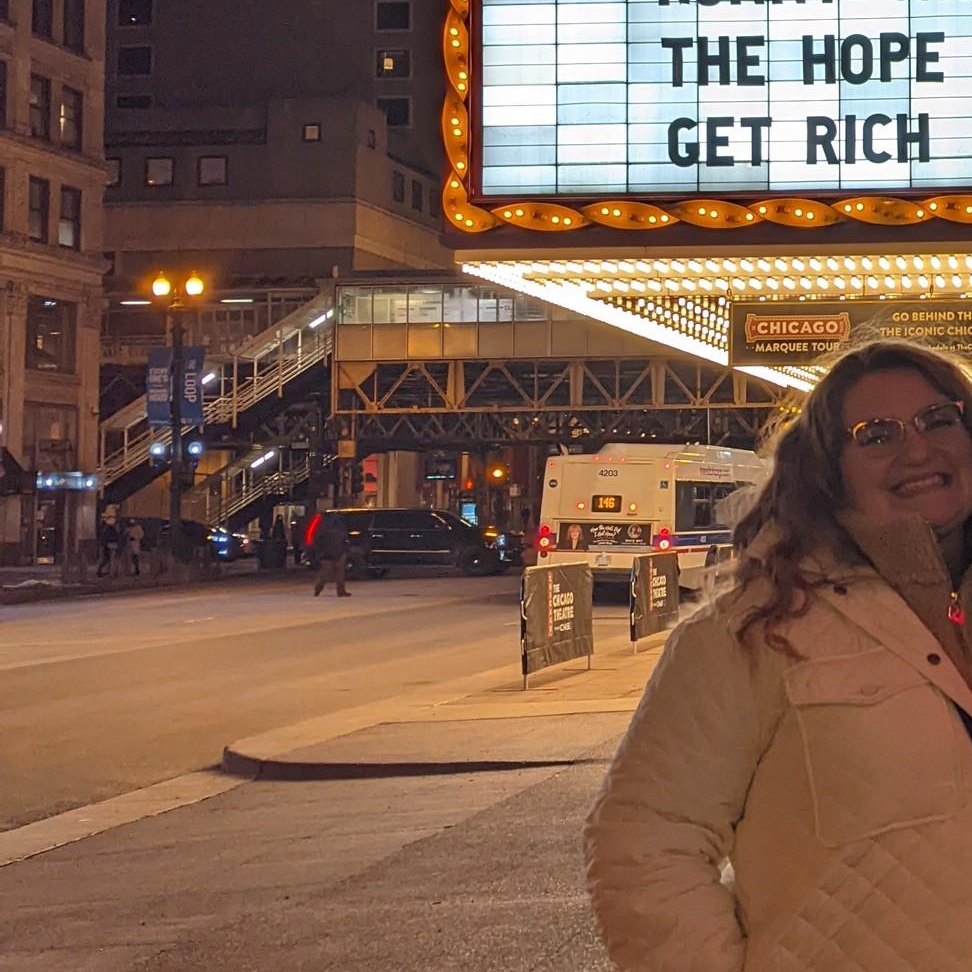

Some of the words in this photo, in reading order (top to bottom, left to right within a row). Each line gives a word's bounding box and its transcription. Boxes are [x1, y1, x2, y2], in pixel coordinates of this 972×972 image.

[661, 35, 765, 87] THE
[802, 32, 945, 84] HOPE
[667, 116, 772, 167] GET
[806, 112, 930, 164] RICH
[892, 312, 910, 322] GO
[912, 310, 955, 321] BEHIND
[756, 321, 839, 334] CHICAGO
[880, 327, 901, 337] THE
[904, 326, 945, 337] ICONIC
[755, 342, 809, 353] MARQUEE
[811, 341, 841, 352] TOUR
[598, 469, 618, 477] 4203
[598, 497, 615, 508] 146
